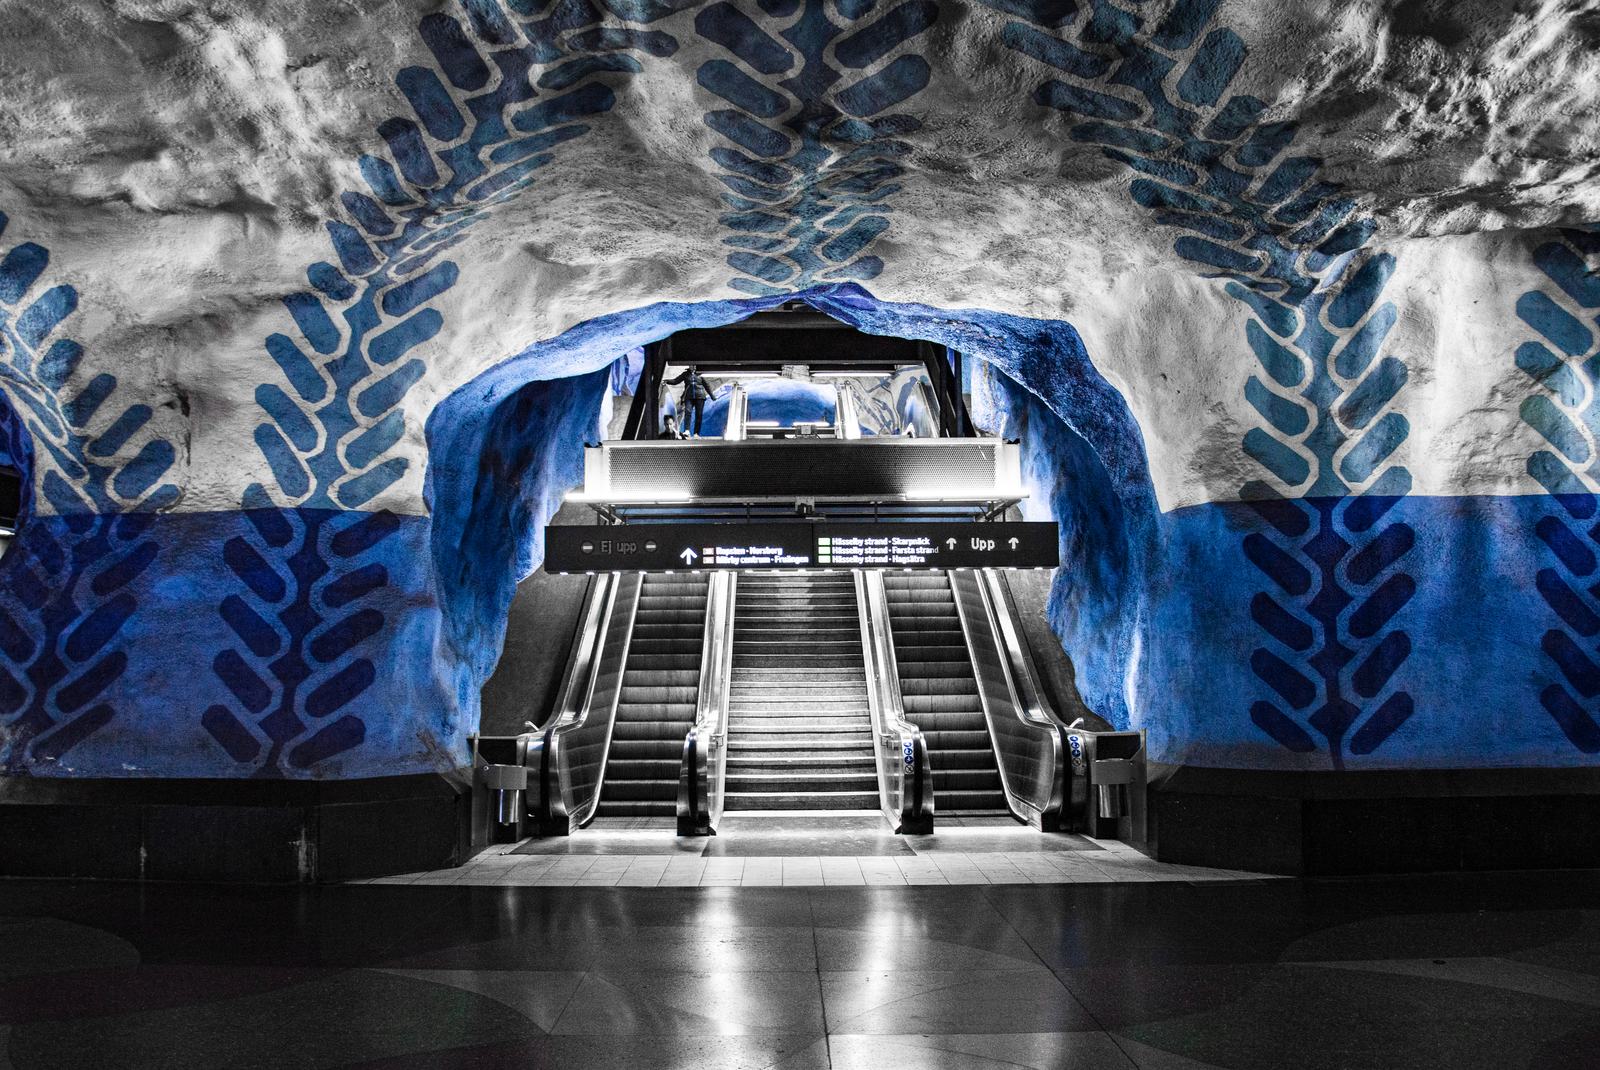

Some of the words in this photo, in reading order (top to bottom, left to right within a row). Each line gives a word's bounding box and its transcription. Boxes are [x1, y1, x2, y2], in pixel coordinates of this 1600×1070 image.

[864, 537, 888, 545] strand
[970, 537, 995, 551] Upp
[601, 540, 612, 555] Ej
[616, 542, 637, 555] upp
[864, 546, 888, 554] strand
[916, 546, 939, 554] strand
[864, 555, 888, 563] strand
